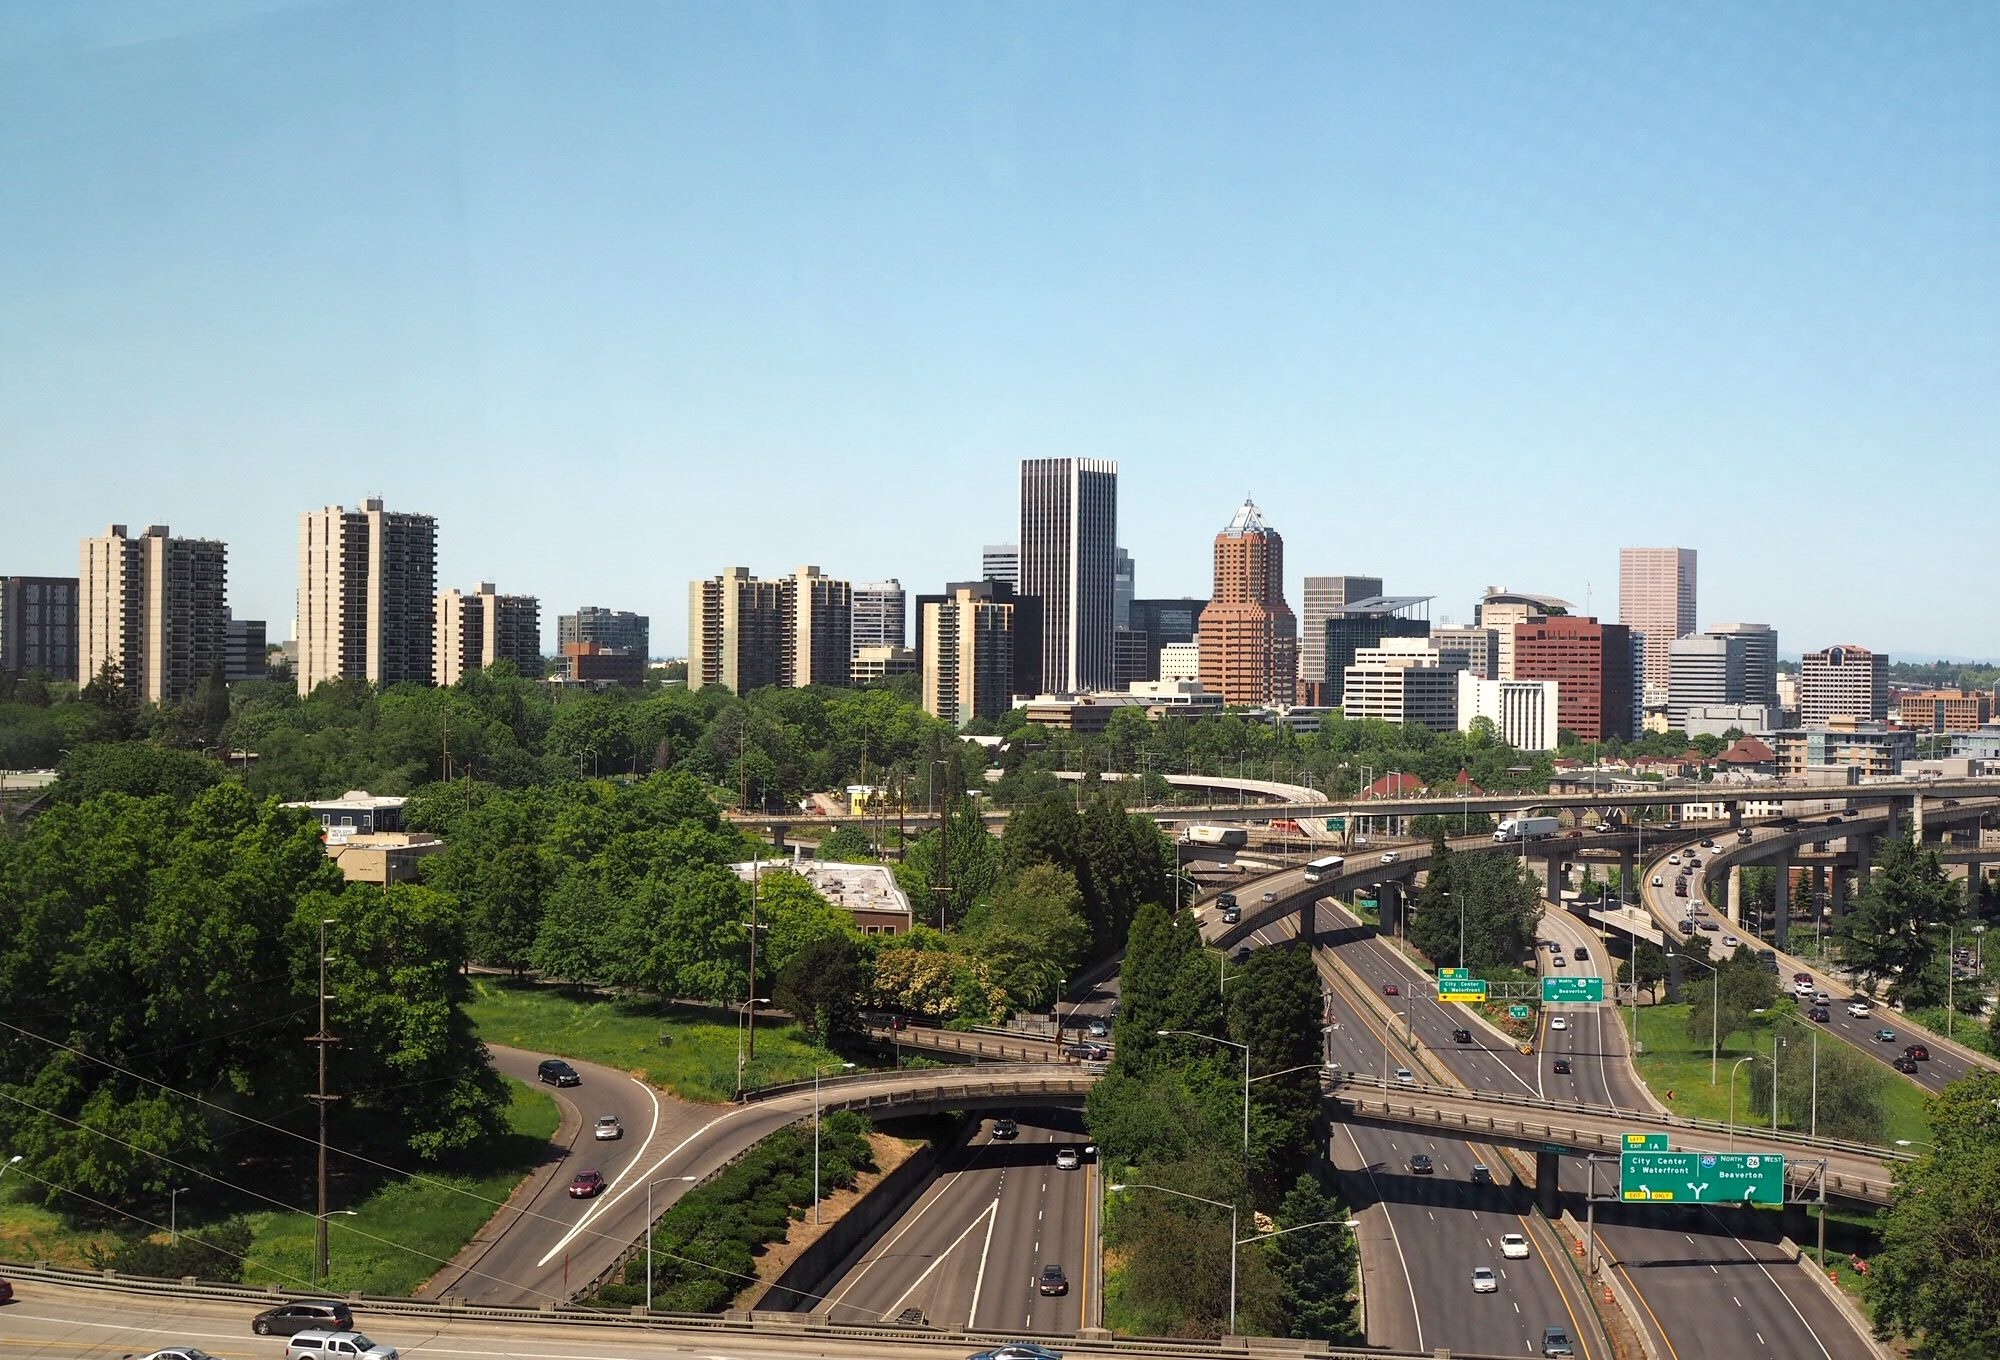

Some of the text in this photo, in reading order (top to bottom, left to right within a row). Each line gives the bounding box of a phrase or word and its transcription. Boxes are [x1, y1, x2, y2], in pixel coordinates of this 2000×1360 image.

[1632, 1157, 1687, 1166] City Center
[1748, 1158, 1758, 1166] 26
[1630, 1166, 1689, 1174] S Waterfront
[1719, 1171, 1763, 1179] Beaverton
